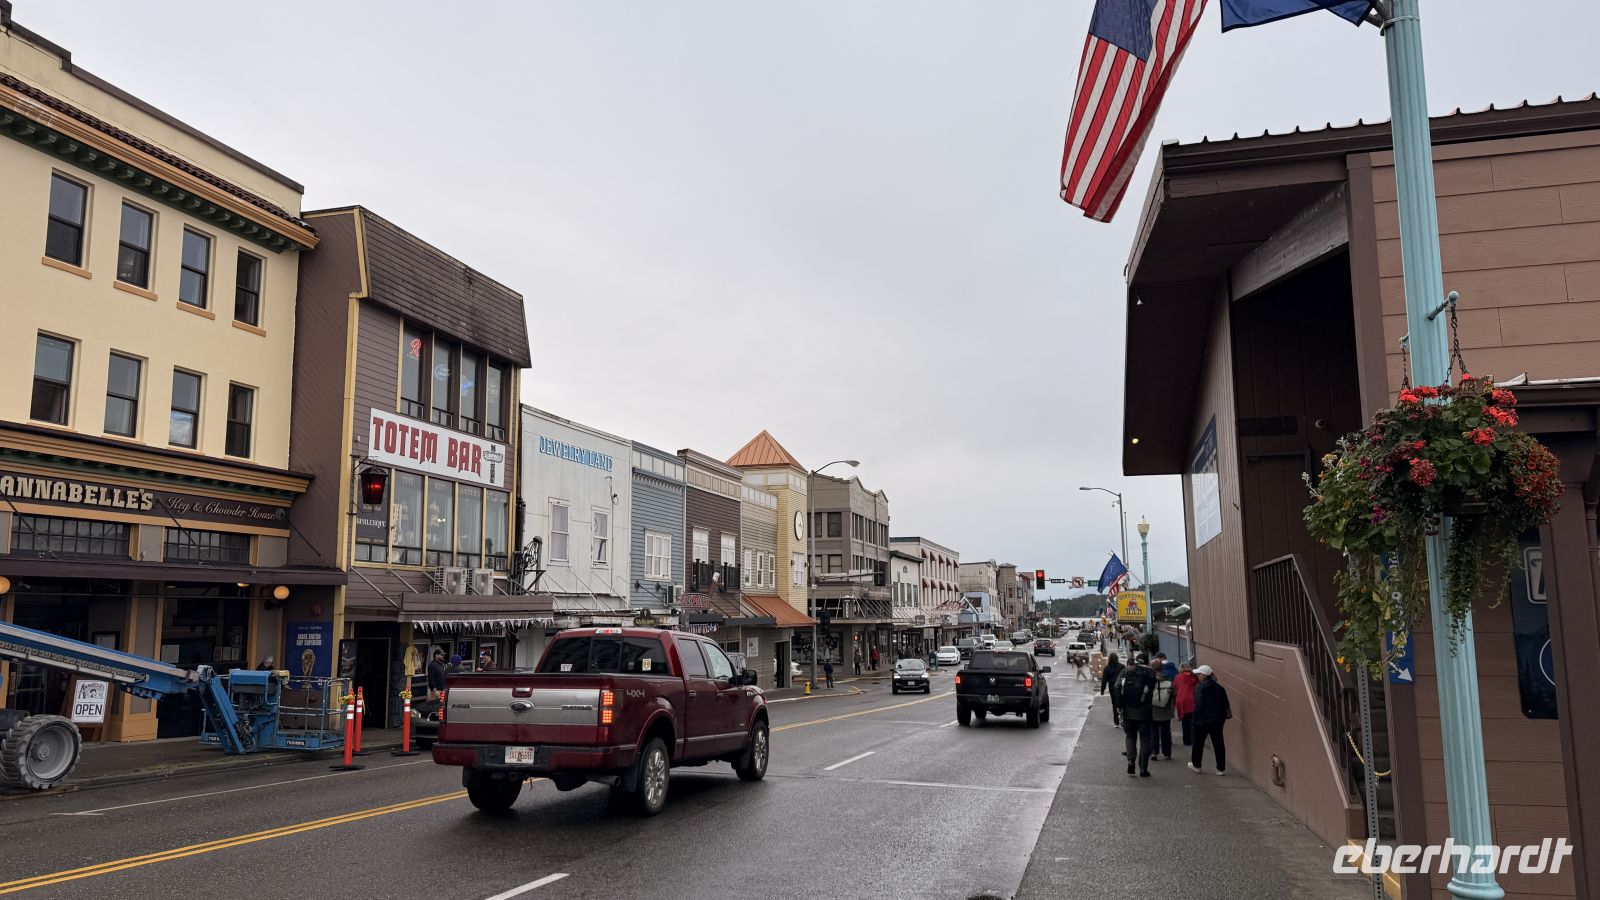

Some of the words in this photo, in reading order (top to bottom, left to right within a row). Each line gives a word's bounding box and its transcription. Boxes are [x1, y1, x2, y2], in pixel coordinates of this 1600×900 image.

[372, 416, 438, 464] TOTEM
[447, 437, 481, 477] BAR
[539, 435, 587, 466] JEWELRY
[588, 450, 613, 472] LAND
[0, 475, 154, 511] ANNABELLE'S
[167, 496, 190, 515] Keg
[193, 503, 203, 512] &
[205, 501, 246, 518] Chowder
[75, 703, 104, 716] OPEN
